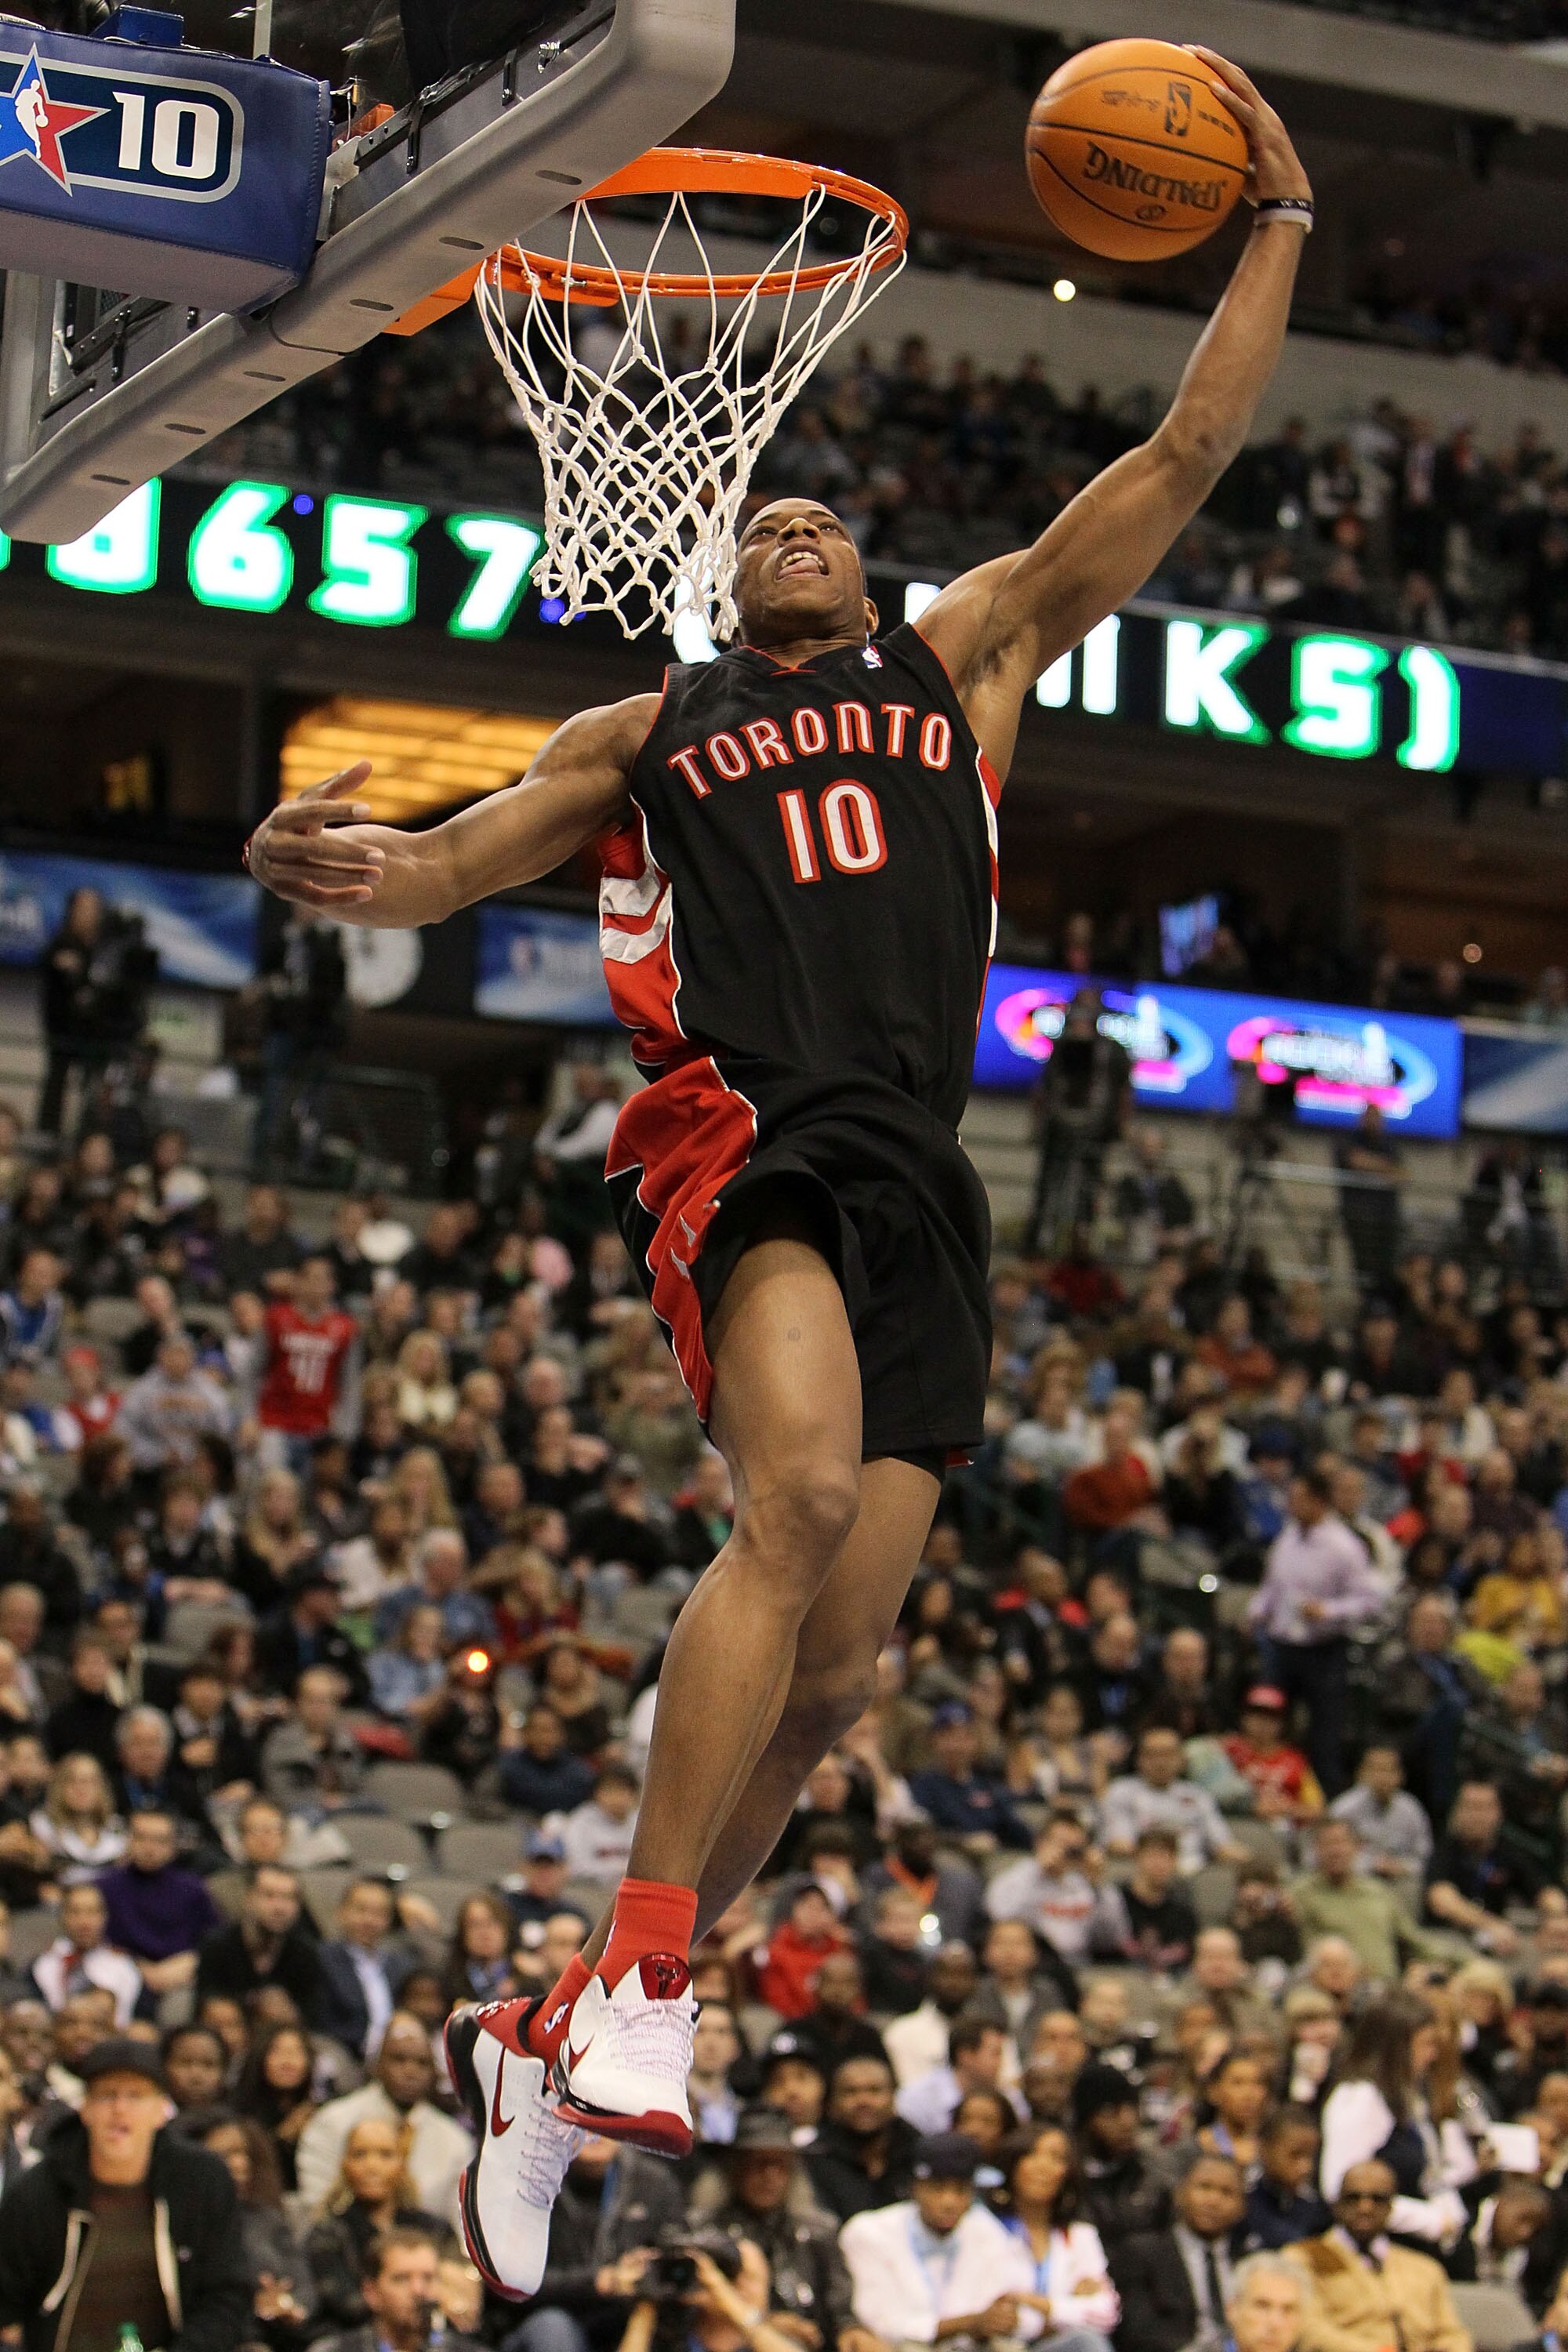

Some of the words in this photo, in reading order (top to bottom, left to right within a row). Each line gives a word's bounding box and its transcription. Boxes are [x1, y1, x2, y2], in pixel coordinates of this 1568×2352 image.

[111, 90, 220, 180] 10
[1083, 141, 1221, 212] SPALDING
[669, 702, 951, 799] TORONTO
[778, 779, 887, 883] 10
